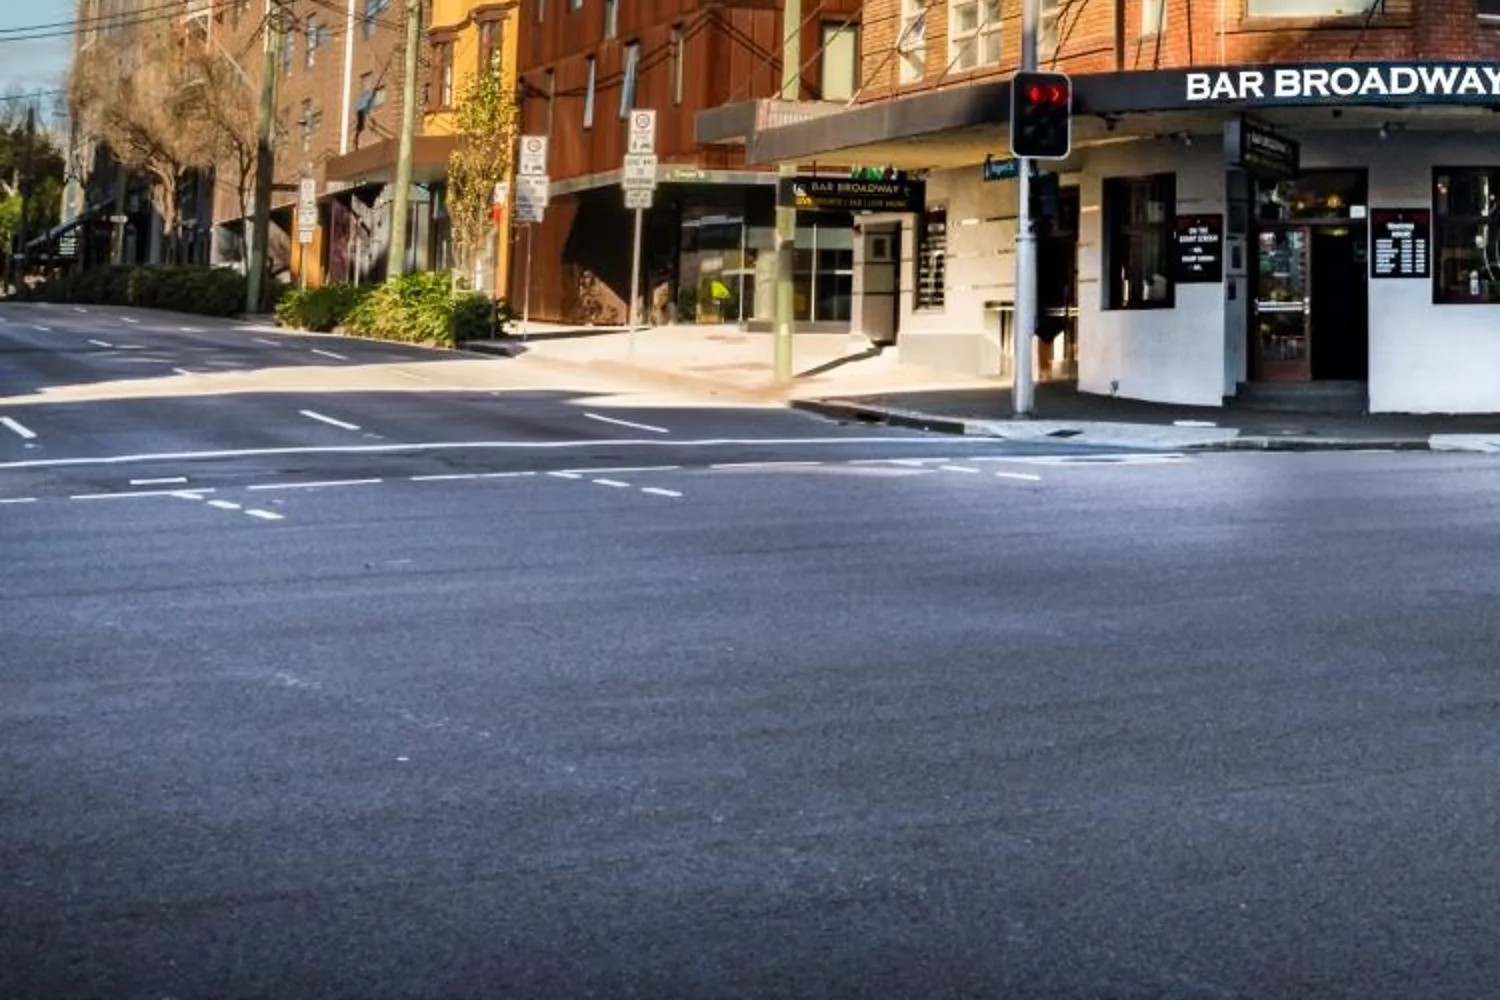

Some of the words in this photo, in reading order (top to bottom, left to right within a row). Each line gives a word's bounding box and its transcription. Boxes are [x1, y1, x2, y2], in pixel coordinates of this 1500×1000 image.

[1186, 71, 1264, 100] BAR
[811, 182, 833, 191] BAR
[837, 183, 899, 194] BROADWAY
